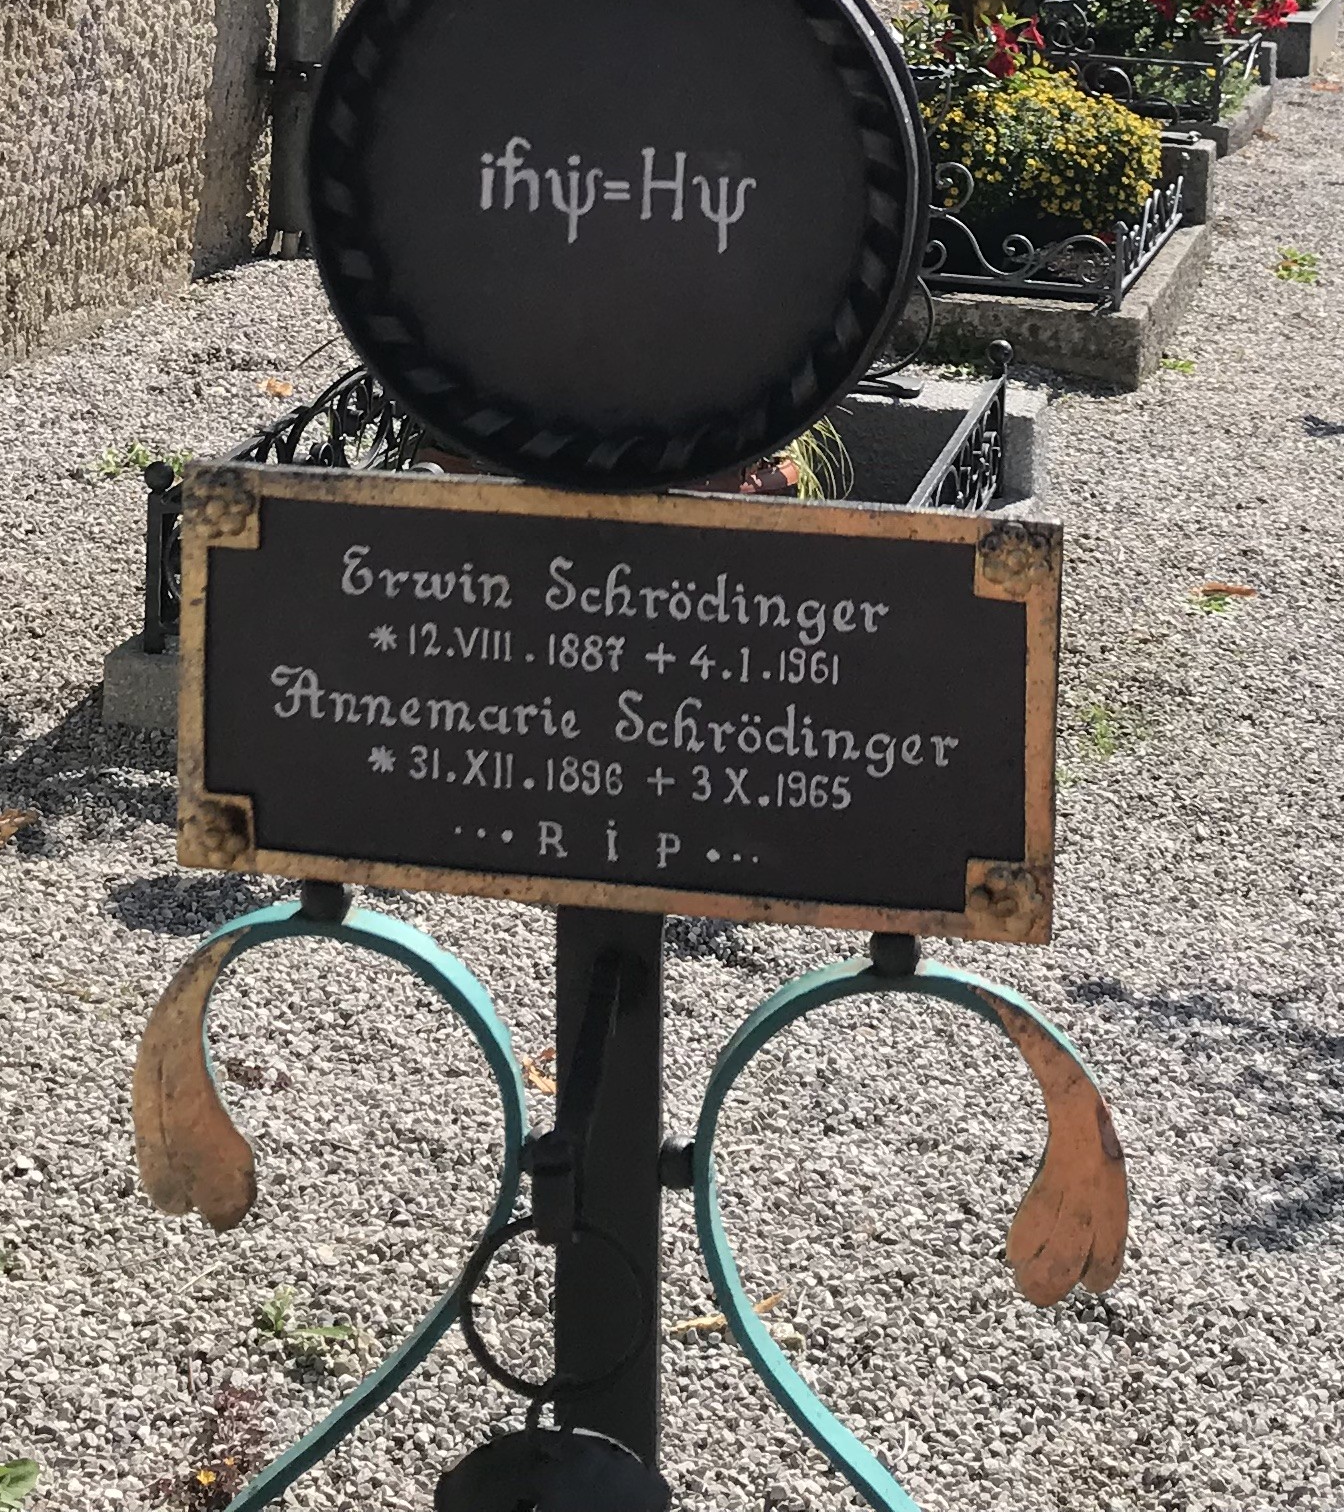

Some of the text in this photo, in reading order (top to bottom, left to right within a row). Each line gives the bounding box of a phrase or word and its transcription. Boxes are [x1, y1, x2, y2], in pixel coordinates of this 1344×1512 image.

[341, 545, 889, 646] Erwin Schrödinger
[270, 664, 959, 778] Annemarie Schrödinger
